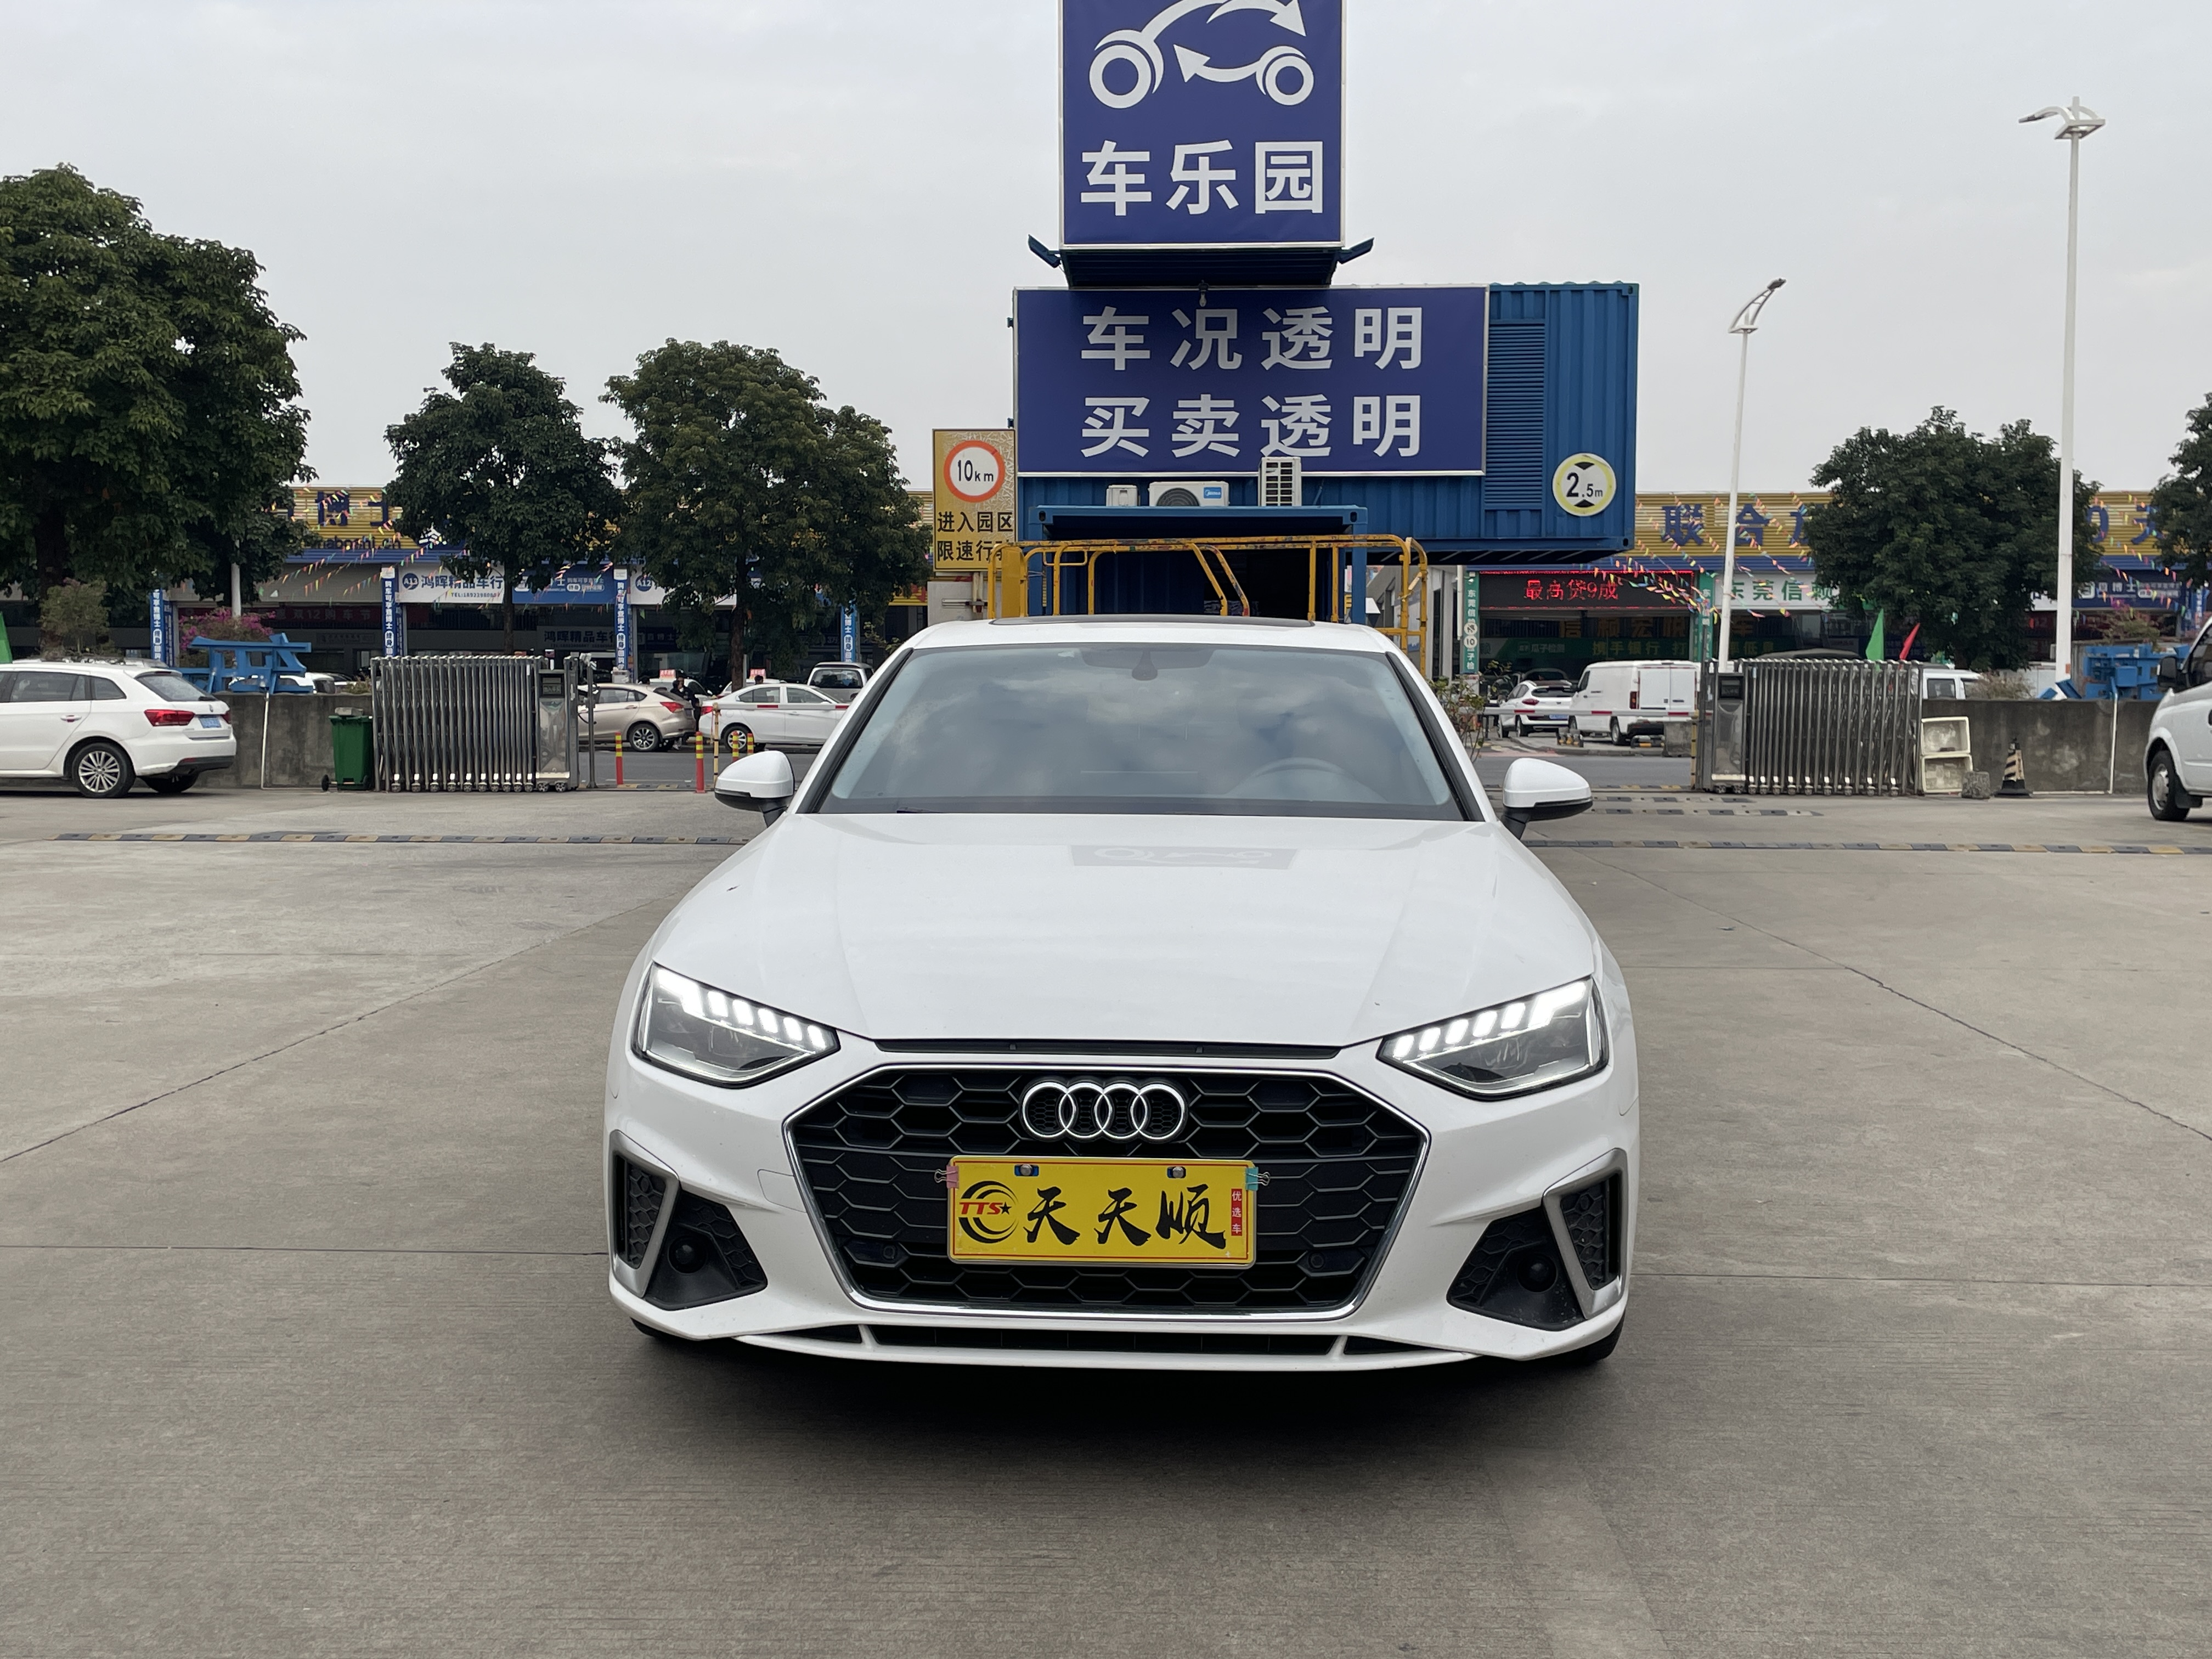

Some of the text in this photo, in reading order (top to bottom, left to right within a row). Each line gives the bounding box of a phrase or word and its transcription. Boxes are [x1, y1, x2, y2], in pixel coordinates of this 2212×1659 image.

[1080, 140, 1324, 217] 车乐园
[1081, 306, 1423, 371] 车况透明
[1081, 393, 1422, 458] 买卖透明
[957, 460, 994, 482] 10km
[1566, 472, 1603, 498] 2.5m
[937, 511, 1014, 533] 进入园区
[1524, 579, 1619, 601] 最高贷9成
[959, 1202, 1003, 1215] TTS
[1023, 1184, 1226, 1250] 天天顺
[1232, 1190, 1243, 1235] 优选车
